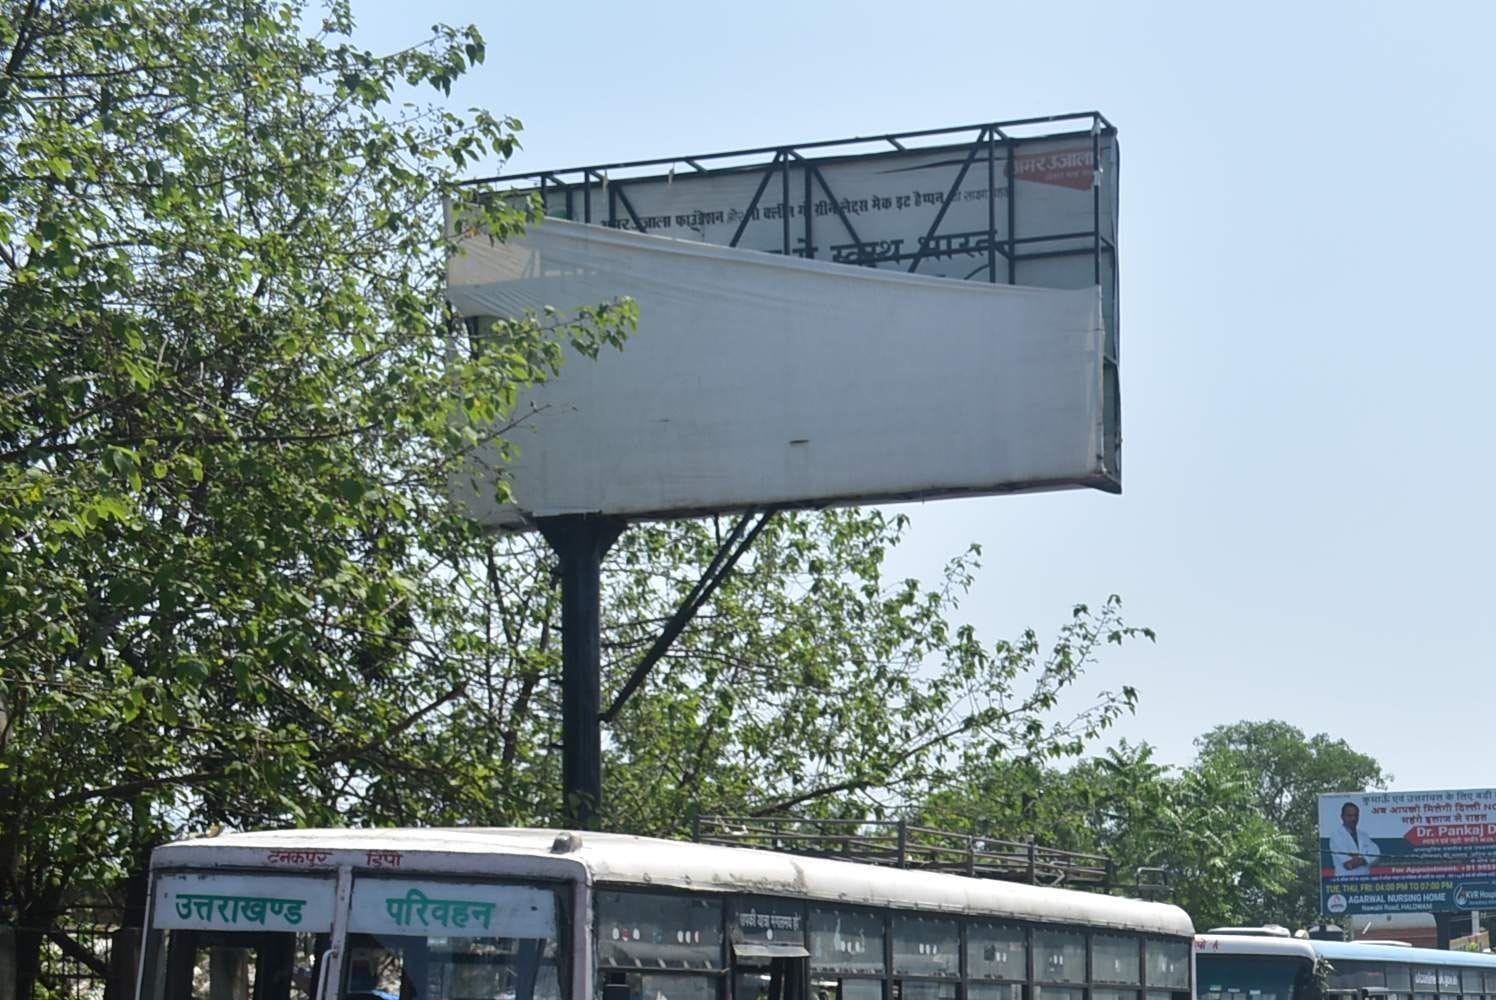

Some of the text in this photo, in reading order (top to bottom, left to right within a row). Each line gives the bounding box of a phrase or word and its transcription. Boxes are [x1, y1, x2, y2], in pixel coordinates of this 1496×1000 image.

[1417, 826, 1434, 838] Dr.
[1439, 825, 1484, 837] Pankaj
[1387, 894, 1421, 903] NURSING
[1423, 893, 1446, 901] HOME
[176, 888, 496, 930] उत्तराखण्ड परिवहन
